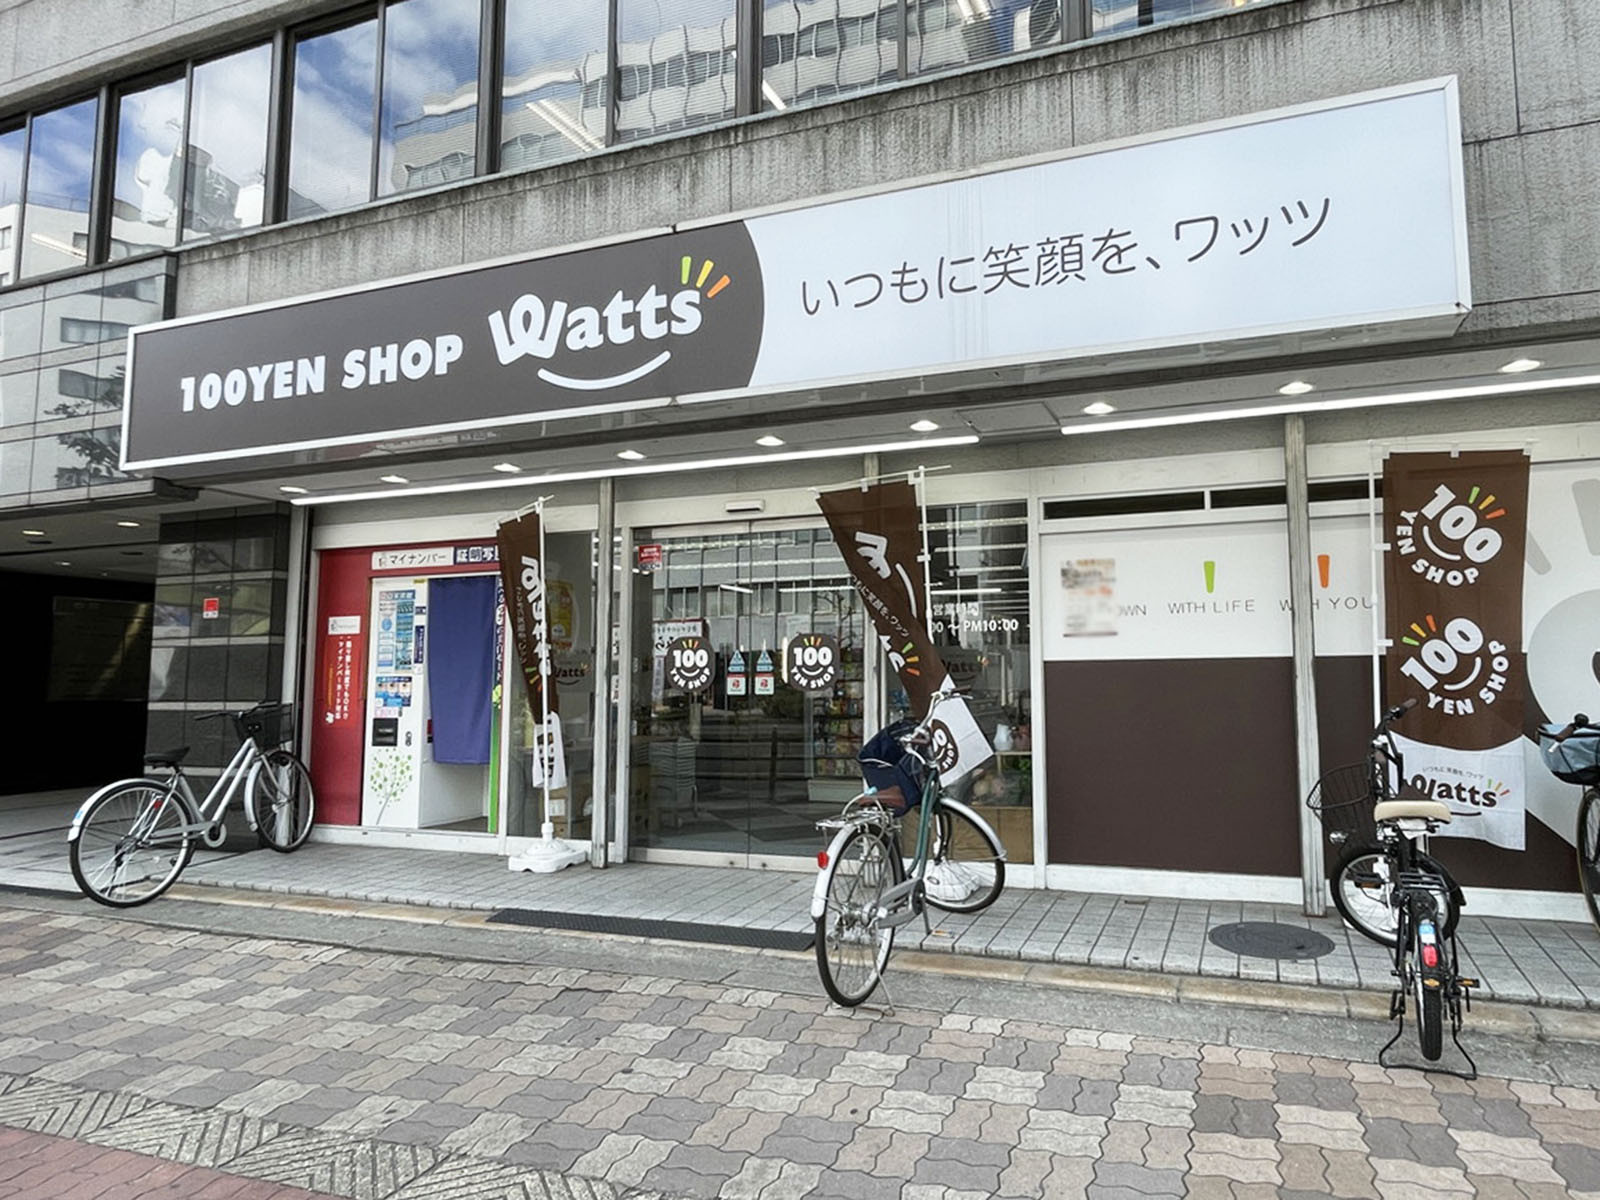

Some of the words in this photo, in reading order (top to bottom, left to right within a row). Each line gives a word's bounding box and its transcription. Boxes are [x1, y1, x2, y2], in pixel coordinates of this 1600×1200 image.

[802, 198, 1330, 315] いつもに笑顔を、ワッツ
[181, 355, 326, 412] 100YEN
[342, 334, 463, 389] SHOP
[488, 285, 702, 365] Watts
[1421, 484, 1502, 563] 100
[389, 553, 447, 564] マイナンバー
[1396, 510, 1418, 555] YEN
[1411, 558, 1479, 586] SHOP
[1168, 601, 1206, 615] WITH
[1213, 599, 1256, 612] LIFE
[1328, 597, 1373, 609] YOU
[963, 618, 1019, 632] PM10:00
[673, 649, 708, 668] 100
[793, 646, 832, 666] 100
[1400, 617, 1483, 690] 100
[670, 667, 686, 687] YEN
[688, 667, 710, 689] SHOP
[791, 666, 808, 687] YEN
[810, 666, 834, 689] SHOP
[1427, 692, 1475, 715] YEN
[1479, 640, 1509, 705] SHOP
